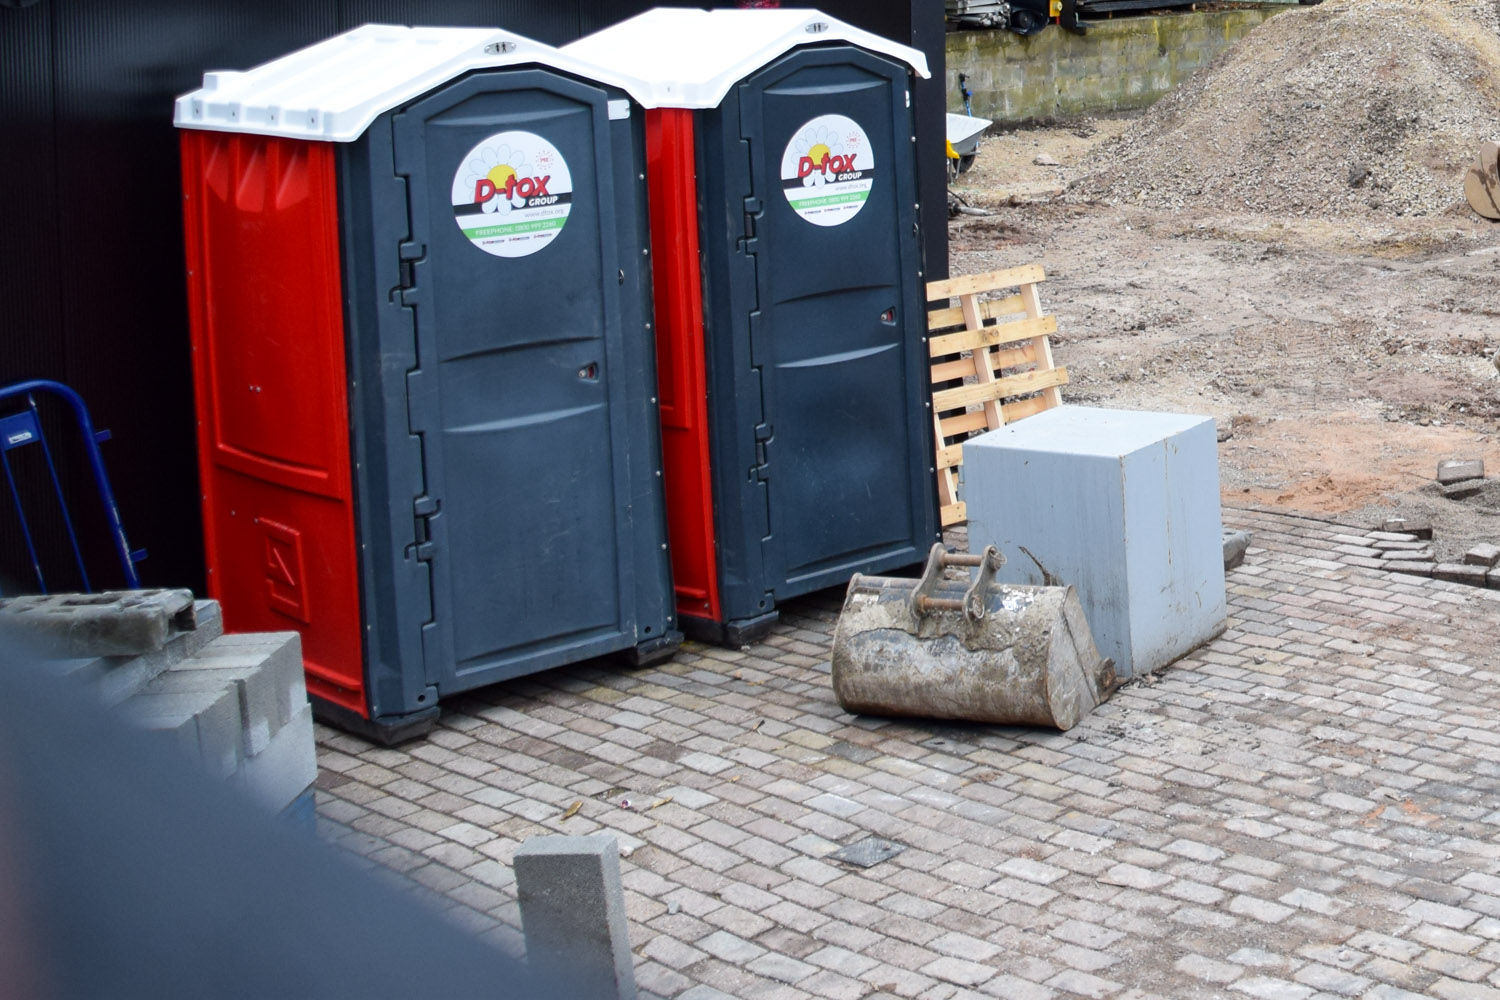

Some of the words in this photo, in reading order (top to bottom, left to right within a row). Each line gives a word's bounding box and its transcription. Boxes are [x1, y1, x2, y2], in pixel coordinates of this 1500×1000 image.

[797, 152, 857, 178] D-tox
[838, 171, 862, 181] GROUP
[474, 174, 551, 203] D-tox
[528, 195, 559, 207] GROUP
[524, 207, 564, 218] www.dtox.org
